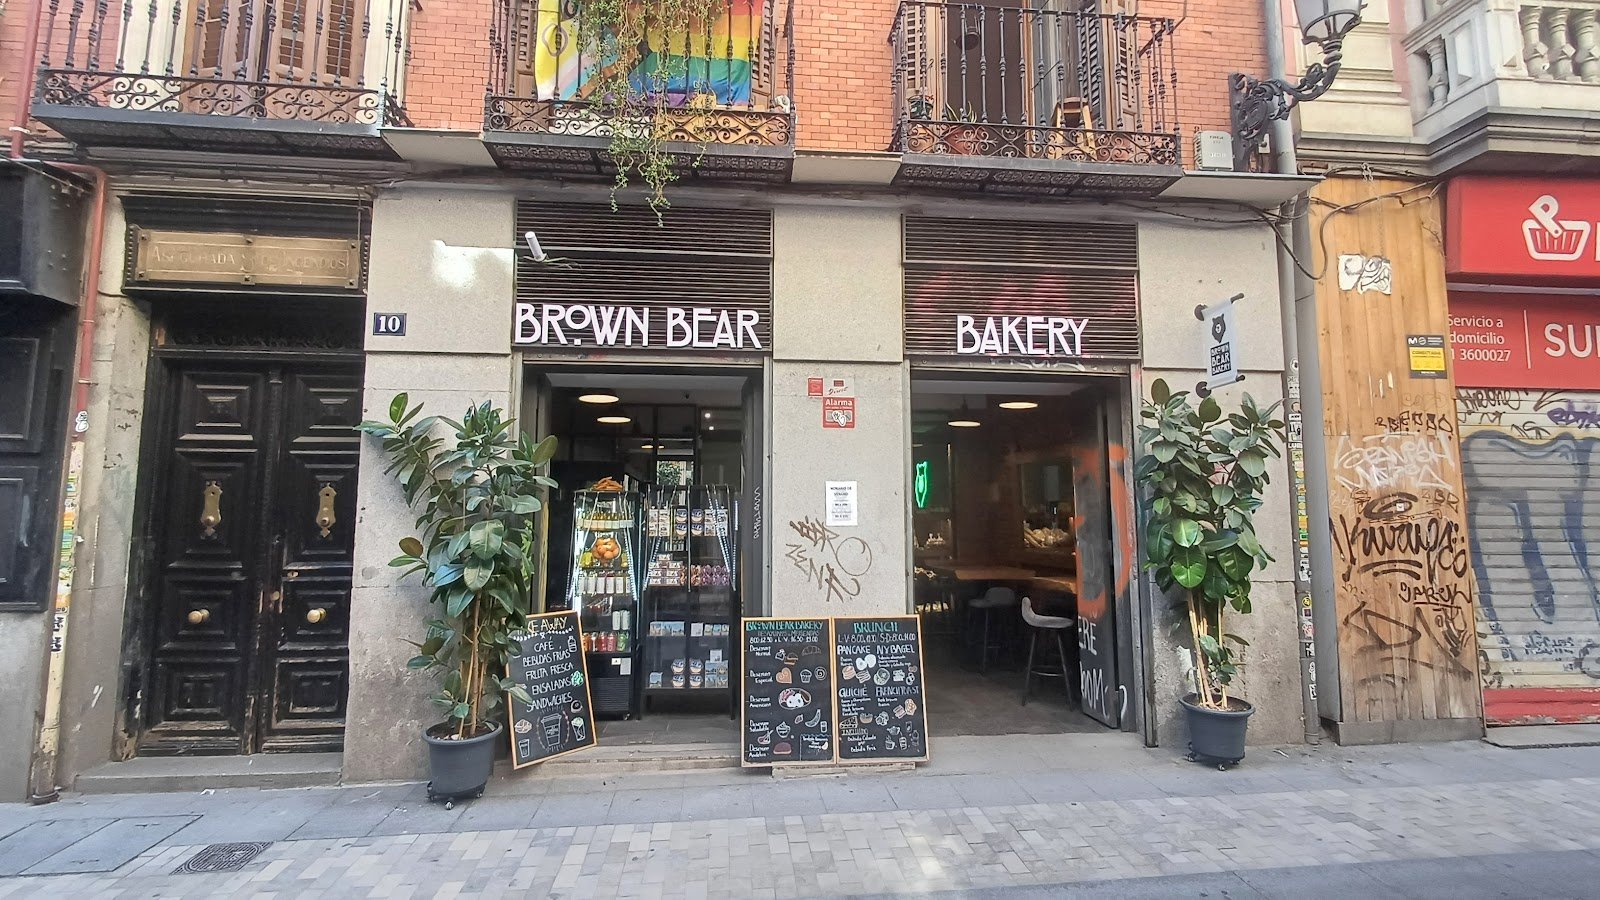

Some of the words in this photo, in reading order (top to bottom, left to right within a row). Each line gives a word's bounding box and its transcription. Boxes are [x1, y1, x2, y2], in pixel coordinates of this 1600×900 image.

[379, 315, 400, 332] 10
[515, 302, 650, 347] BROWN
[666, 306, 762, 349] BEAR
[1448, 314, 1494, 328] Servicio
[1496, 318, 1504, 328] a
[956, 315, 1090, 356] BAKERY
[1450, 331, 1505, 345] domicilio
[1212, 352, 1230, 367] BEAR
[1460, 348, 1511, 362] 3600027
[825, 398, 853, 406] Alarma
[540, 616, 567, 631] AWAY
[853, 621, 899, 634] BRUNCH
[533, 636, 555, 652] CAFÉ
[836, 644, 871, 656] PANCAKE
[890, 643, 916, 655] BAGEL
[525, 667, 549, 681] FRUTA
[550, 661, 574, 675] FRESCA
[531, 677, 571, 695] ENSALADAS
[526, 691, 573, 713] SANDWICHES
